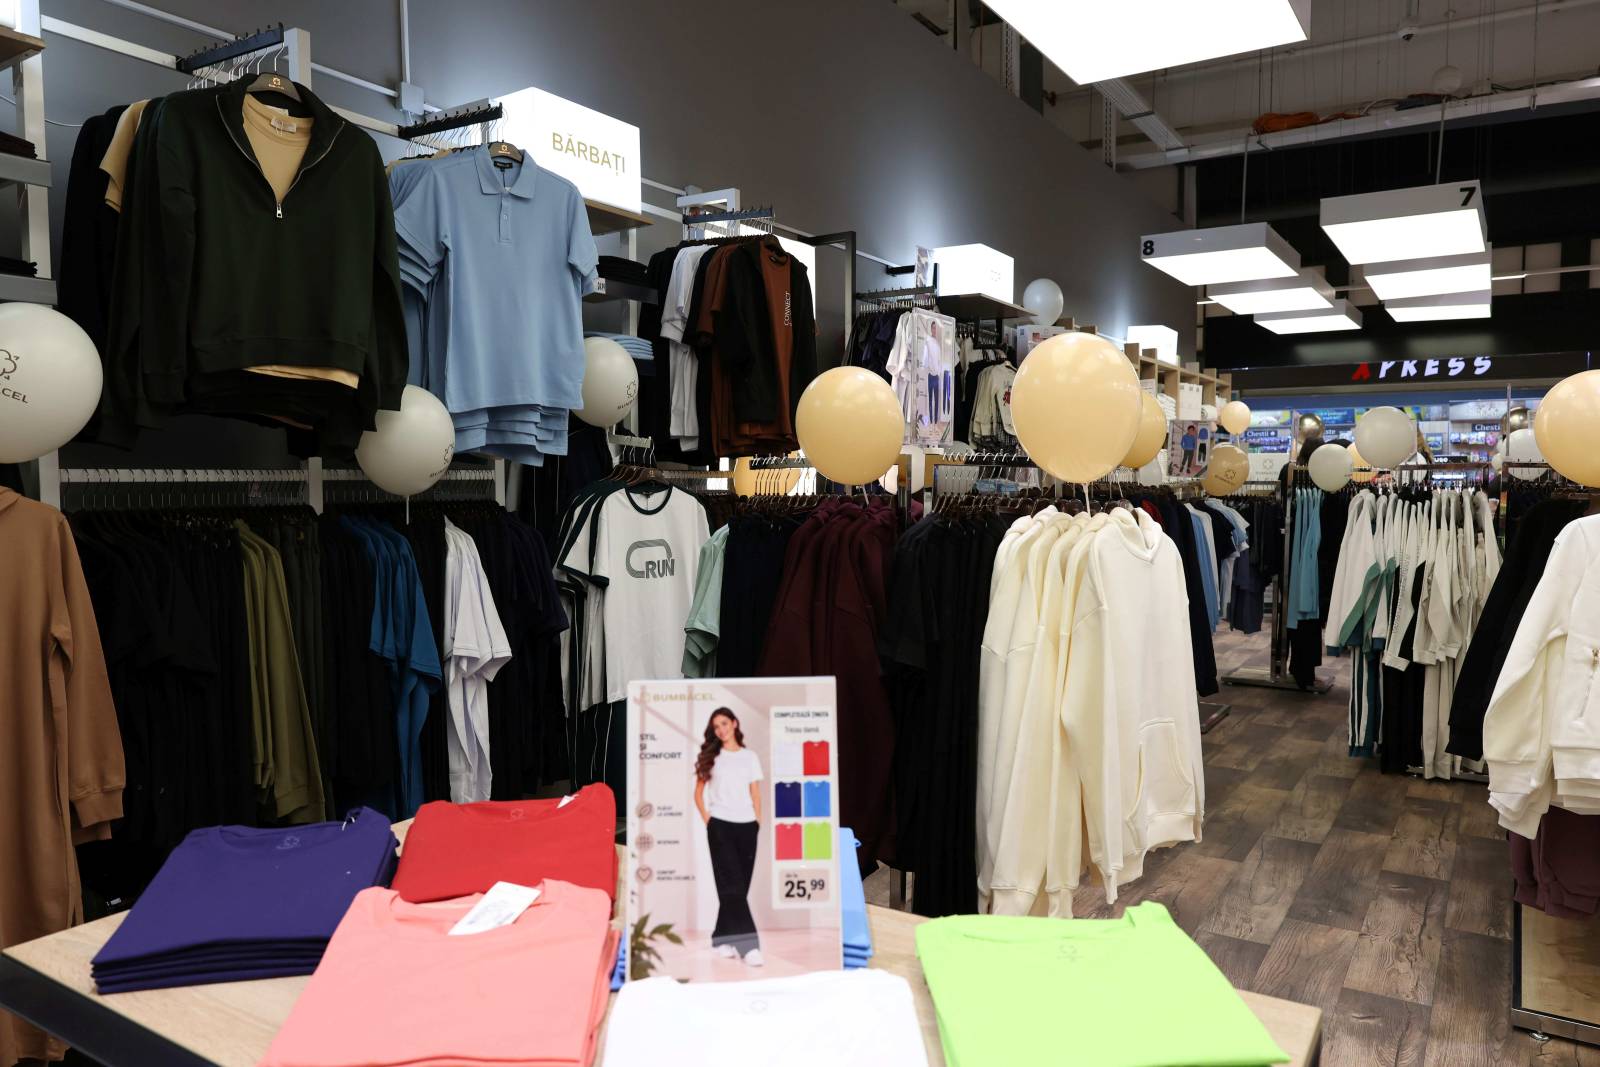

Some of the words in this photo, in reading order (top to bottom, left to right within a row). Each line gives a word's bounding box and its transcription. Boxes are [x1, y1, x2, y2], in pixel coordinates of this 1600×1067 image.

[552, 132, 625, 176] BĂRBAȚI
[1459, 186, 1477, 206] 7
[1142, 240, 1155, 256] 8
[1, 387, 29, 404] CEL
[640, 733, 656, 741] STIL
[640, 752, 682, 760] CONFORT
